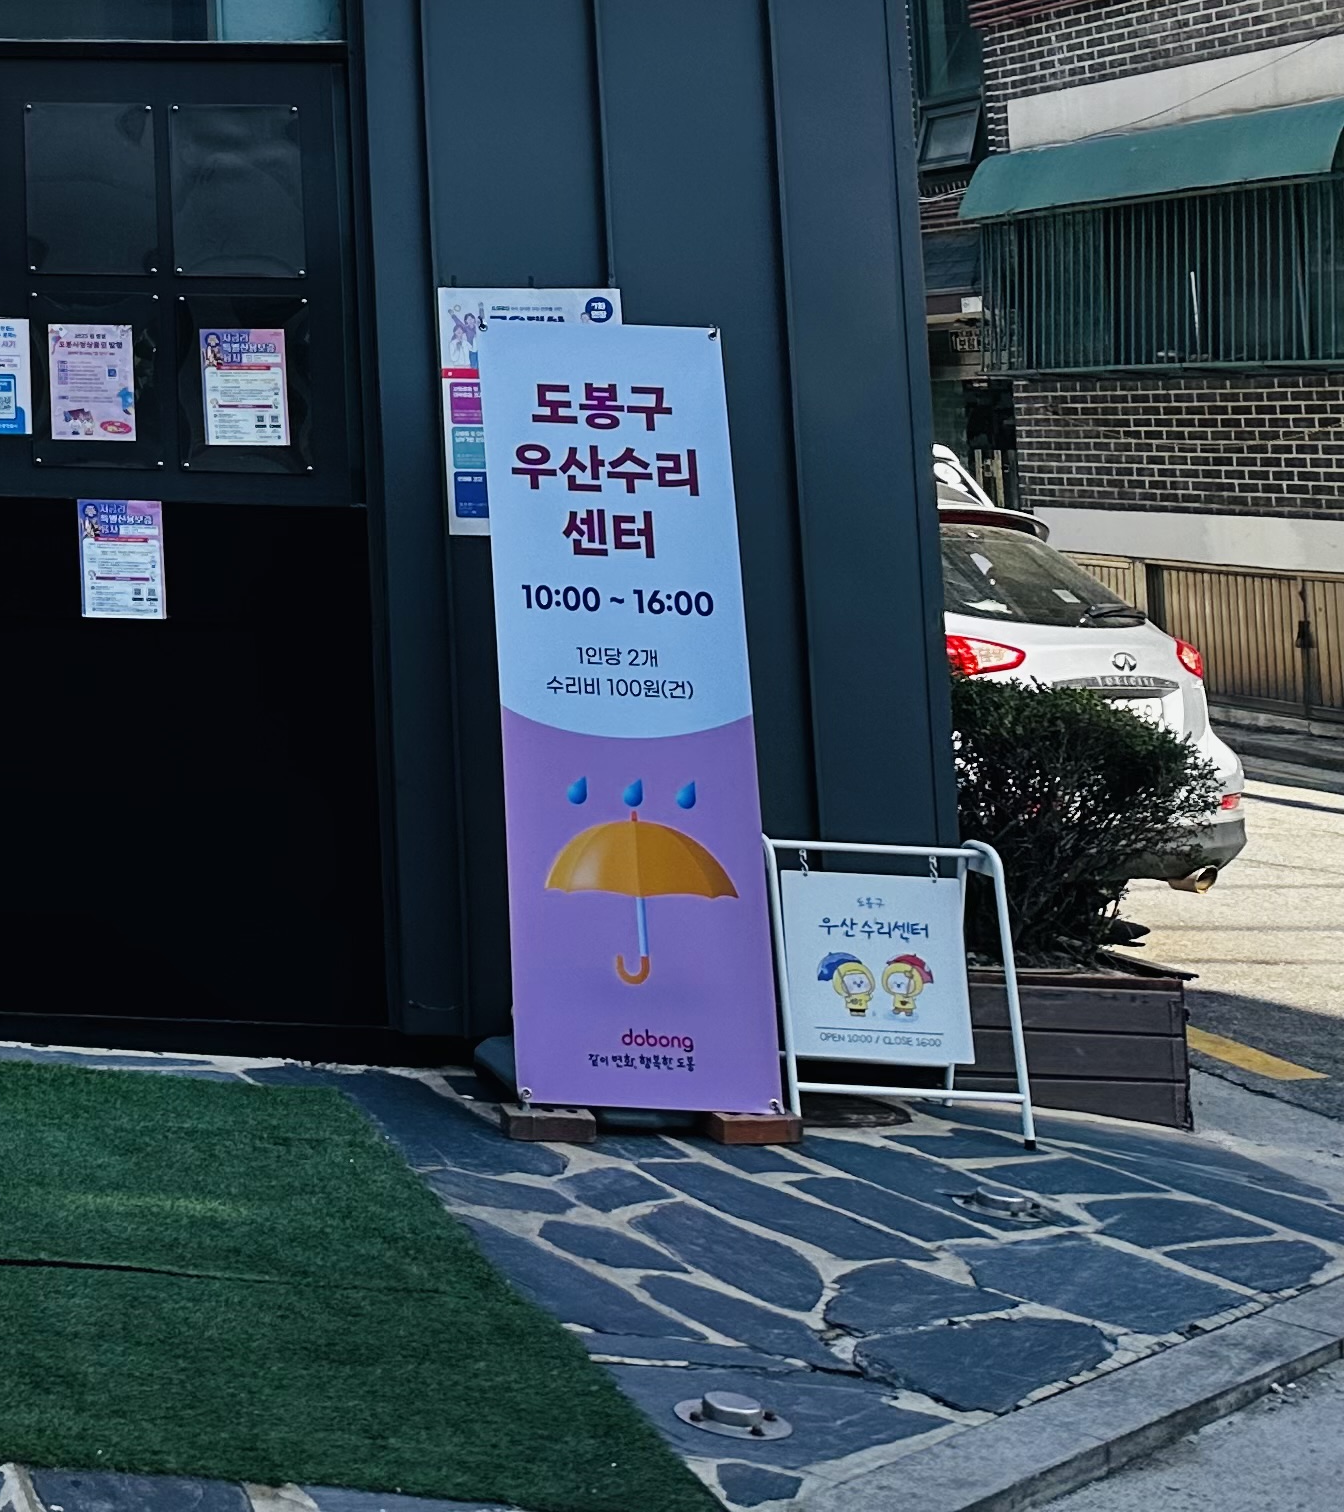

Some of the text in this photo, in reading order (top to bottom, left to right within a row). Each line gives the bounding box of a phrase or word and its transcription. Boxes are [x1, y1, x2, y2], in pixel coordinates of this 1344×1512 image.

[532, 382, 672, 431] 도봉구
[512, 443, 700, 497] 우산수리
[562, 509, 655, 559] 센터
[521, 584, 600, 612] 10:00
[632, 589, 714, 617] 16:00
[576, 646, 658, 668] 1인당 2개
[546, 675, 694, 700] 수리비 100원(건)
[856, 897, 885, 909] 도봉구
[621, 1028, 694, 1053] dobong
[820, 1031, 845, 1042] OPEN
[882, 1035, 913, 1046] CLOSE
[639, 1053, 674, 1070] 행복한
[677, 1056, 696, 1072] 도봉
